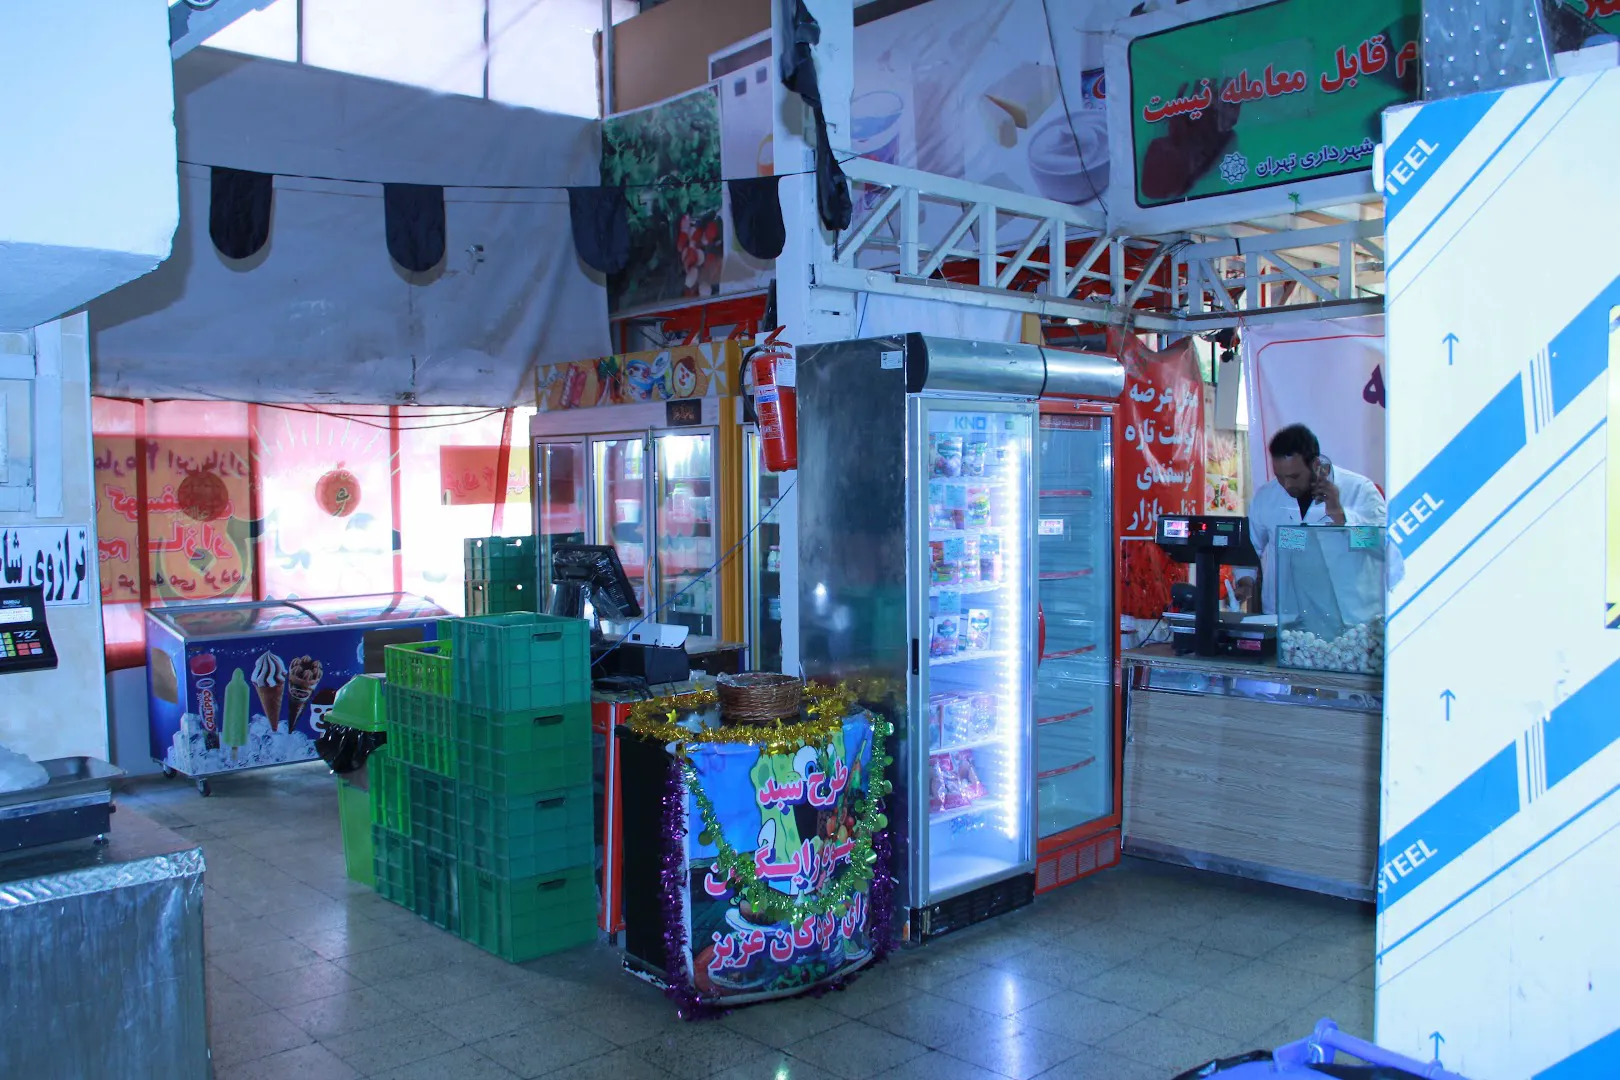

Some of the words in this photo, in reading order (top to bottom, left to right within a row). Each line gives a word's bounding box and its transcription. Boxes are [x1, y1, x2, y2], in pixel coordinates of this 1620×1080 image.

[1320, 34, 1387, 93] قابل
[1143, 78, 1212, 122] نیست
[1221, 64, 1306, 104] معامله
[1255, 152, 1296, 177] تهران
[1300, 136, 1374, 168] شهرداری
[1129, 380, 1174, 413] عرضه
[1124, 418, 1156, 451] تازه
[1136, 460, 1195, 492] گوسفندی
[28, 528, 86, 602] ترازوی
[758, 776, 804, 811] سبد
[806, 757, 848, 807] طرح
[704, 838, 820, 896] رایگن
[821, 837, 857, 877] یوه
[841, 890, 869, 939] رای
[707, 928, 767, 971] عزیز
